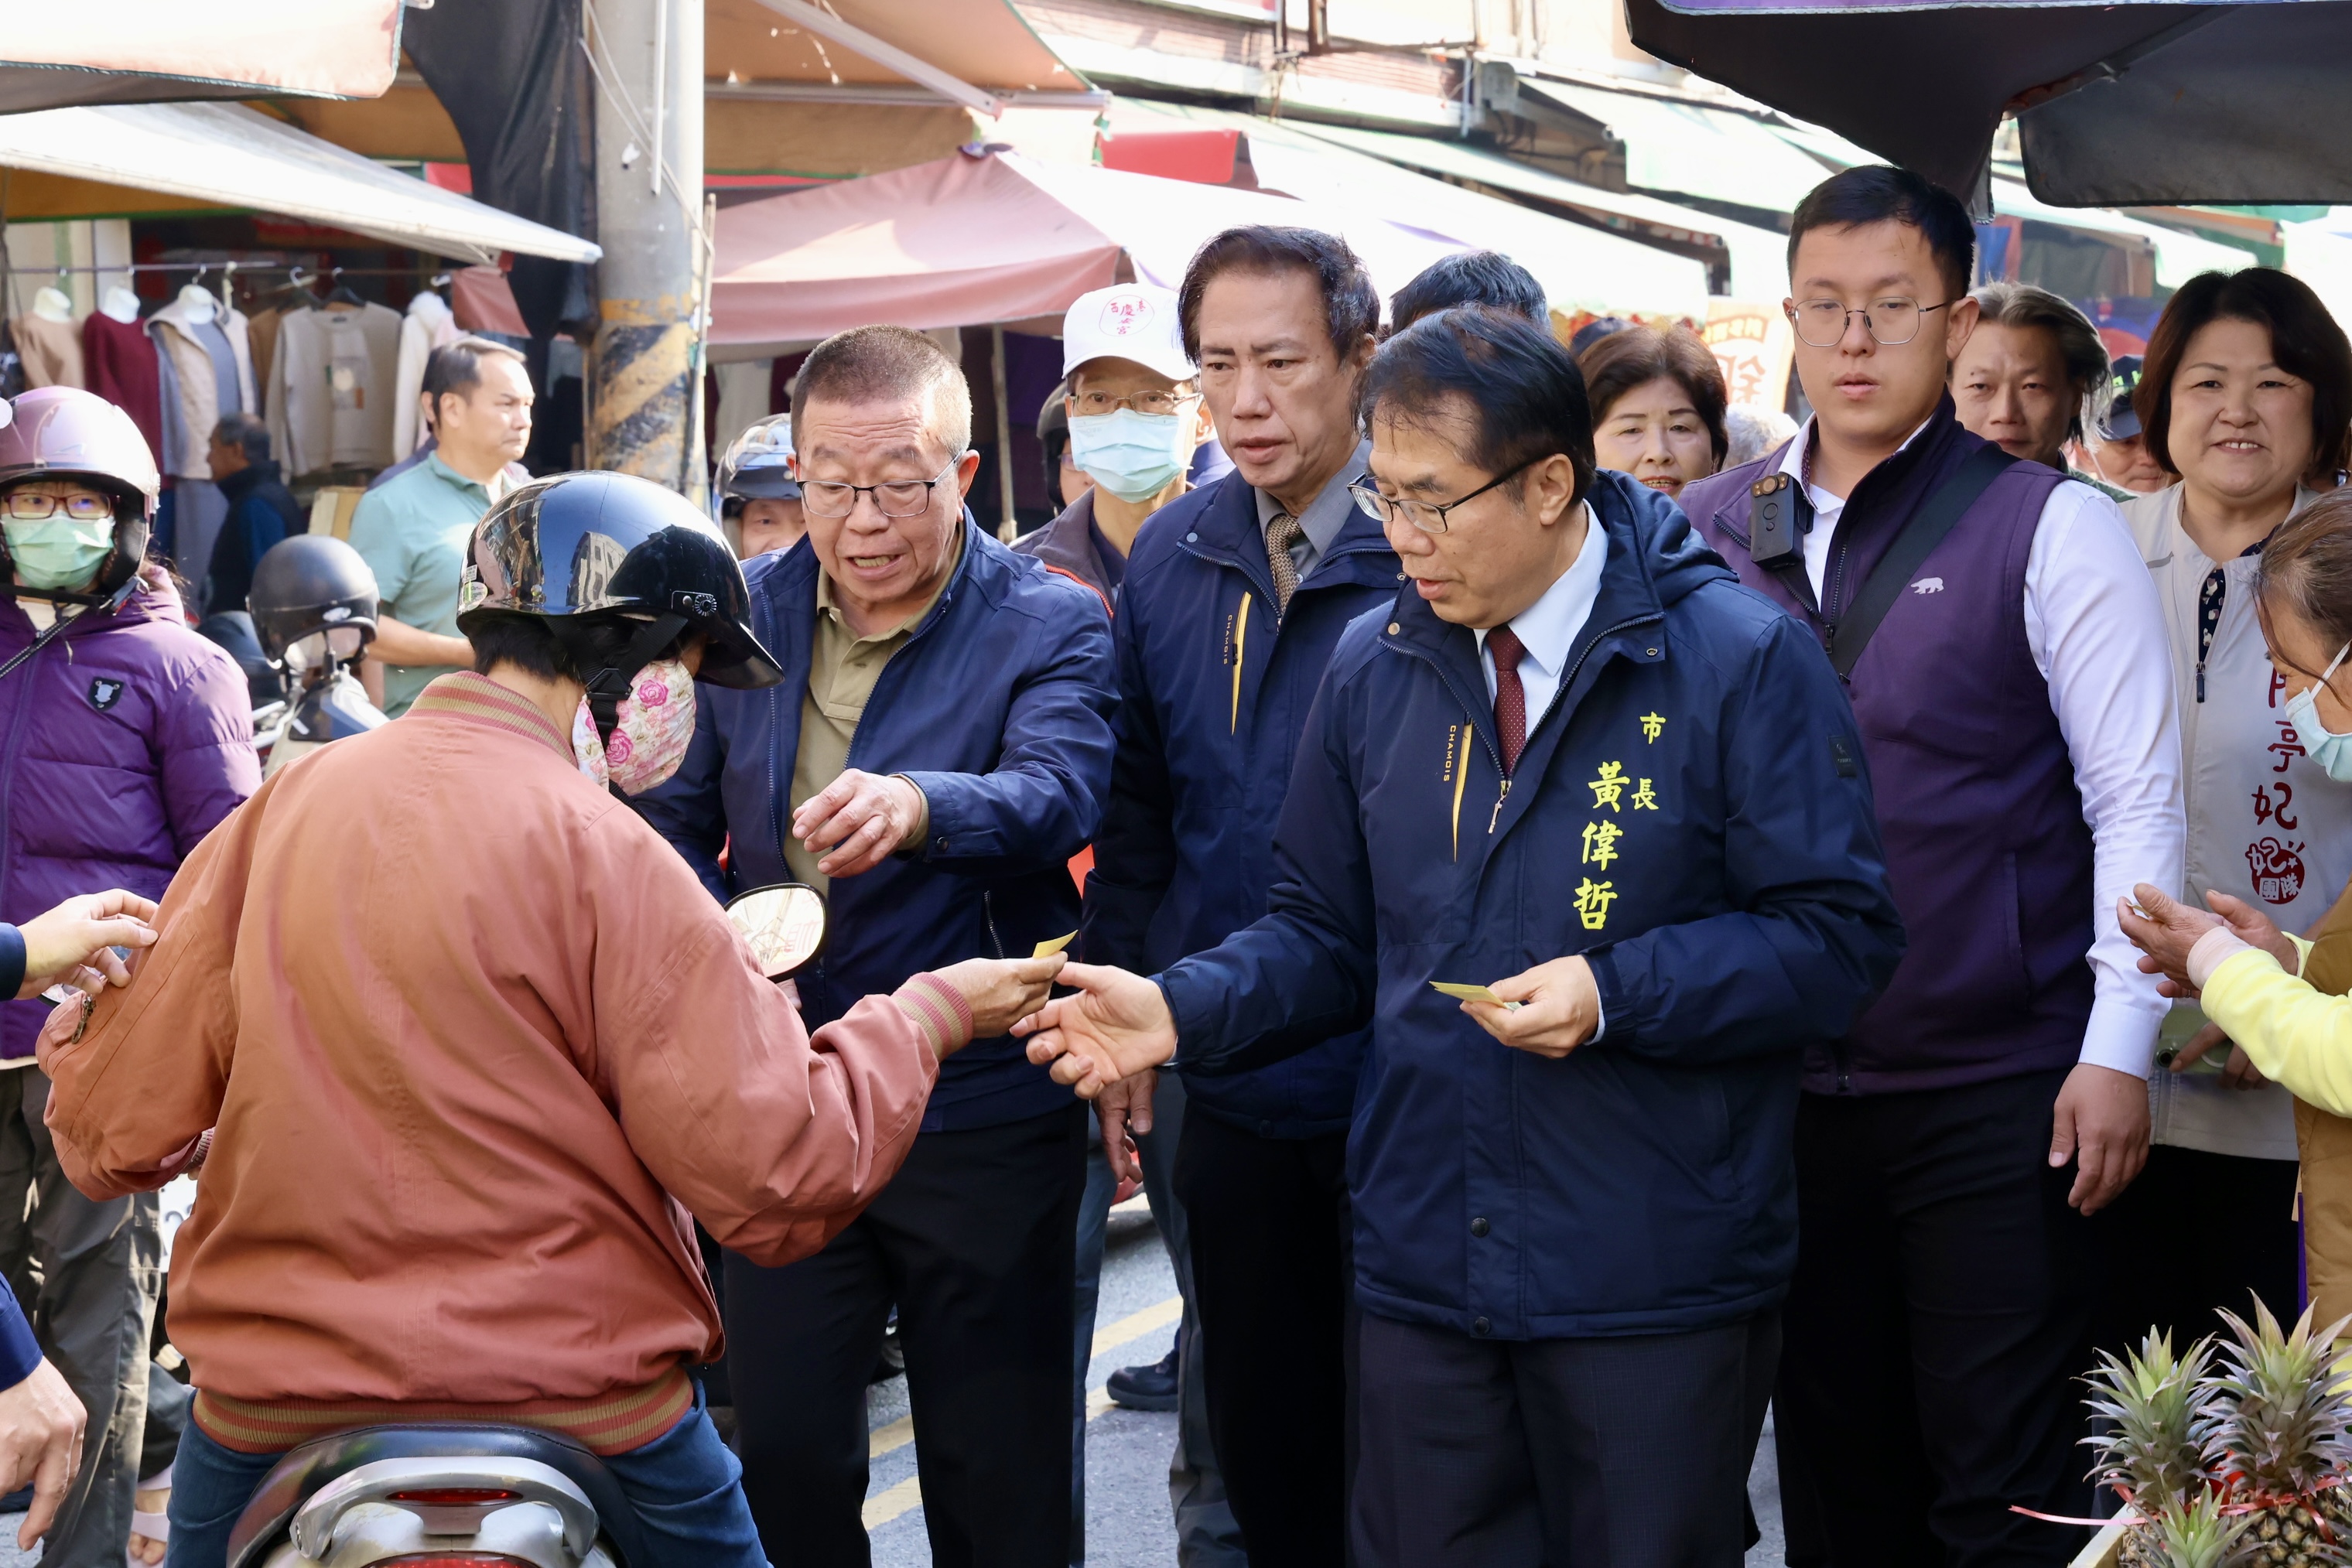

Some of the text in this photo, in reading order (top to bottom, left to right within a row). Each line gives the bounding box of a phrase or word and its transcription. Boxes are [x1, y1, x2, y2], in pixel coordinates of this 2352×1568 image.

[1443, 725, 1457, 781] CHAMOIS
[1573, 760, 1631, 930] 黃偉哲
[2259, 873, 2299, 900] 團隊
